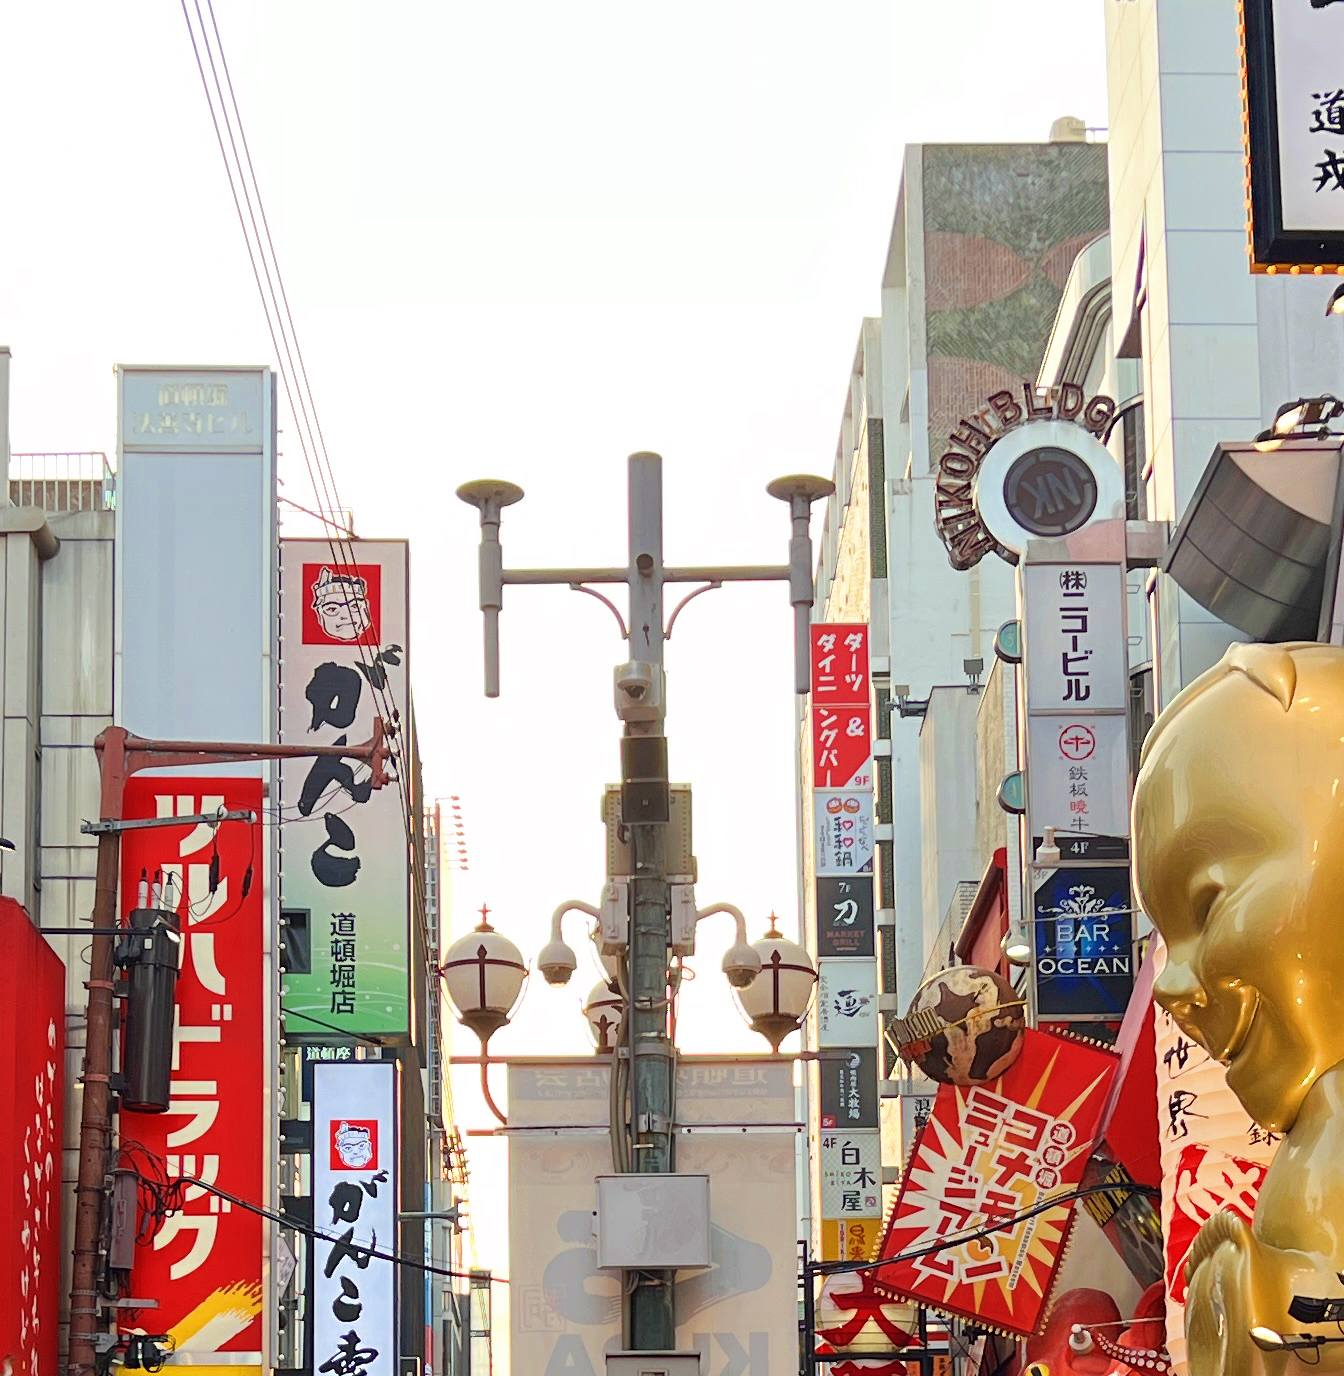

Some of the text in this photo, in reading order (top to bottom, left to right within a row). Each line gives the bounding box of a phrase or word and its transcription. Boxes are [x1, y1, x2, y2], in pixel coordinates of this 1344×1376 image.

[843, 632, 864, 693] ダーツ
[845, 716, 866, 738] &
[299, 645, 404, 888] がんこ
[854, 775, 870, 786] 9F
[1069, 841, 1089, 855] 4F
[838, 882, 852, 893] 7F
[1056, 923, 1111, 943] BAR
[330, 912, 356, 1014] 道頓堀店
[1037, 956, 1130, 977] OCEAN
[1160, 1036, 1211, 1142] 世界
[822, 1137, 837, 1149] 4F
